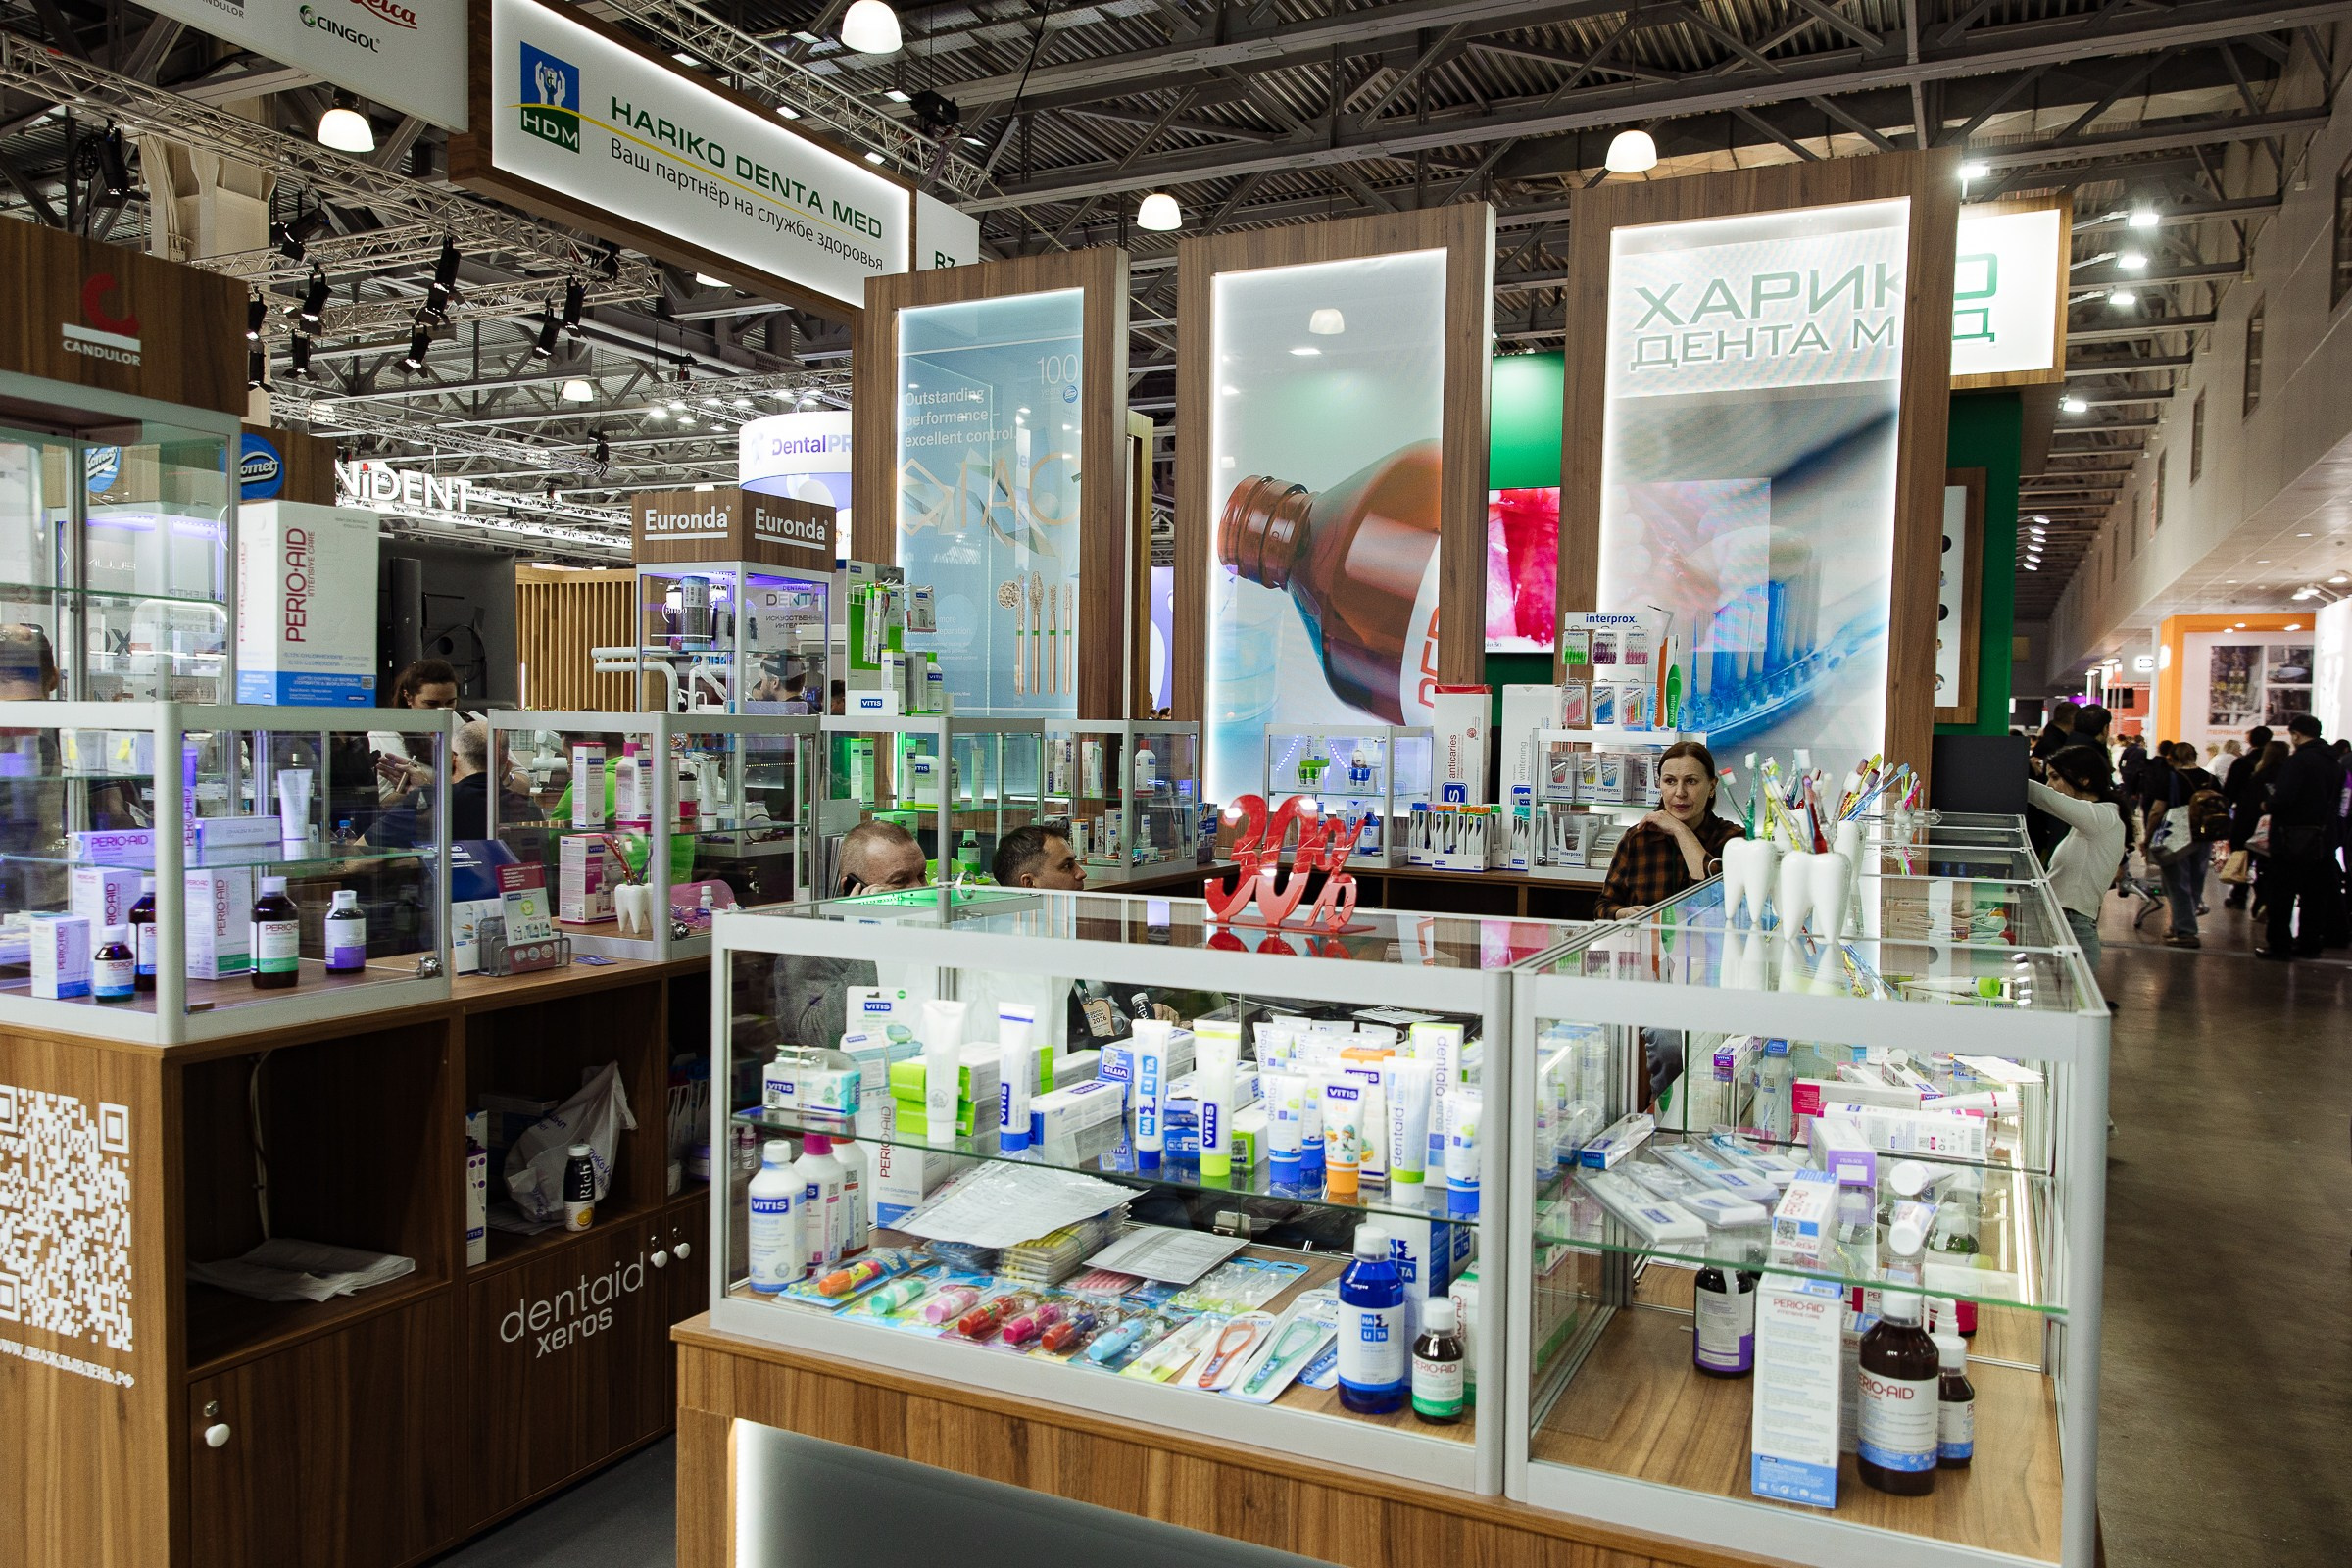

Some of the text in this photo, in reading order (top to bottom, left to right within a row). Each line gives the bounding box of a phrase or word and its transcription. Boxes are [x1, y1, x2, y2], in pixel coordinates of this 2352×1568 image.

[351, 0, 417, 25] eica
[317, 17, 379, 53] CINGOL
[523, 111, 579, 149] HDM
[612, 96, 881, 239] HARIKO DENTA MED
[611, 136, 882, 271] Ваш партнёр на службе здоровья
[62, 339, 141, 366] CANDULOR
[1630, 322, 1830, 371] ДЕНТА
[1037, 354, 1079, 385] 100
[905, 388, 985, 406] Outstanding
[906, 410, 989, 428] performance
[905, 430, 962, 448] excellent
[241, 460, 278, 476] omet
[645, 506, 728, 531] Euronda
[755, 508, 825, 541] Euronda
[1520, 741, 1529, 781] whitening
[1093, 1015, 1107, 1024] 2026
[1103, 1067, 1128, 1077] VITIS
[767, 1081, 793, 1093] VITIS
[1329, 1088, 1357, 1099] VITIS
[1001, 1085, 1010, 1122] VITIS
[1205, 1105, 1214, 1146] VITIS
[1394, 1107, 1404, 1167] dentaid
[580, 1164, 592, 1199] Rich
[752, 1199, 788, 1212] VITIS
[466, 1229, 483, 1239] ITIS
[1401, 1266, 1412, 1277] TA
[500, 1251, 644, 1343] dentaid
[536, 1307, 612, 1358] xeros
[1377, 1331, 1388, 1340] TA
